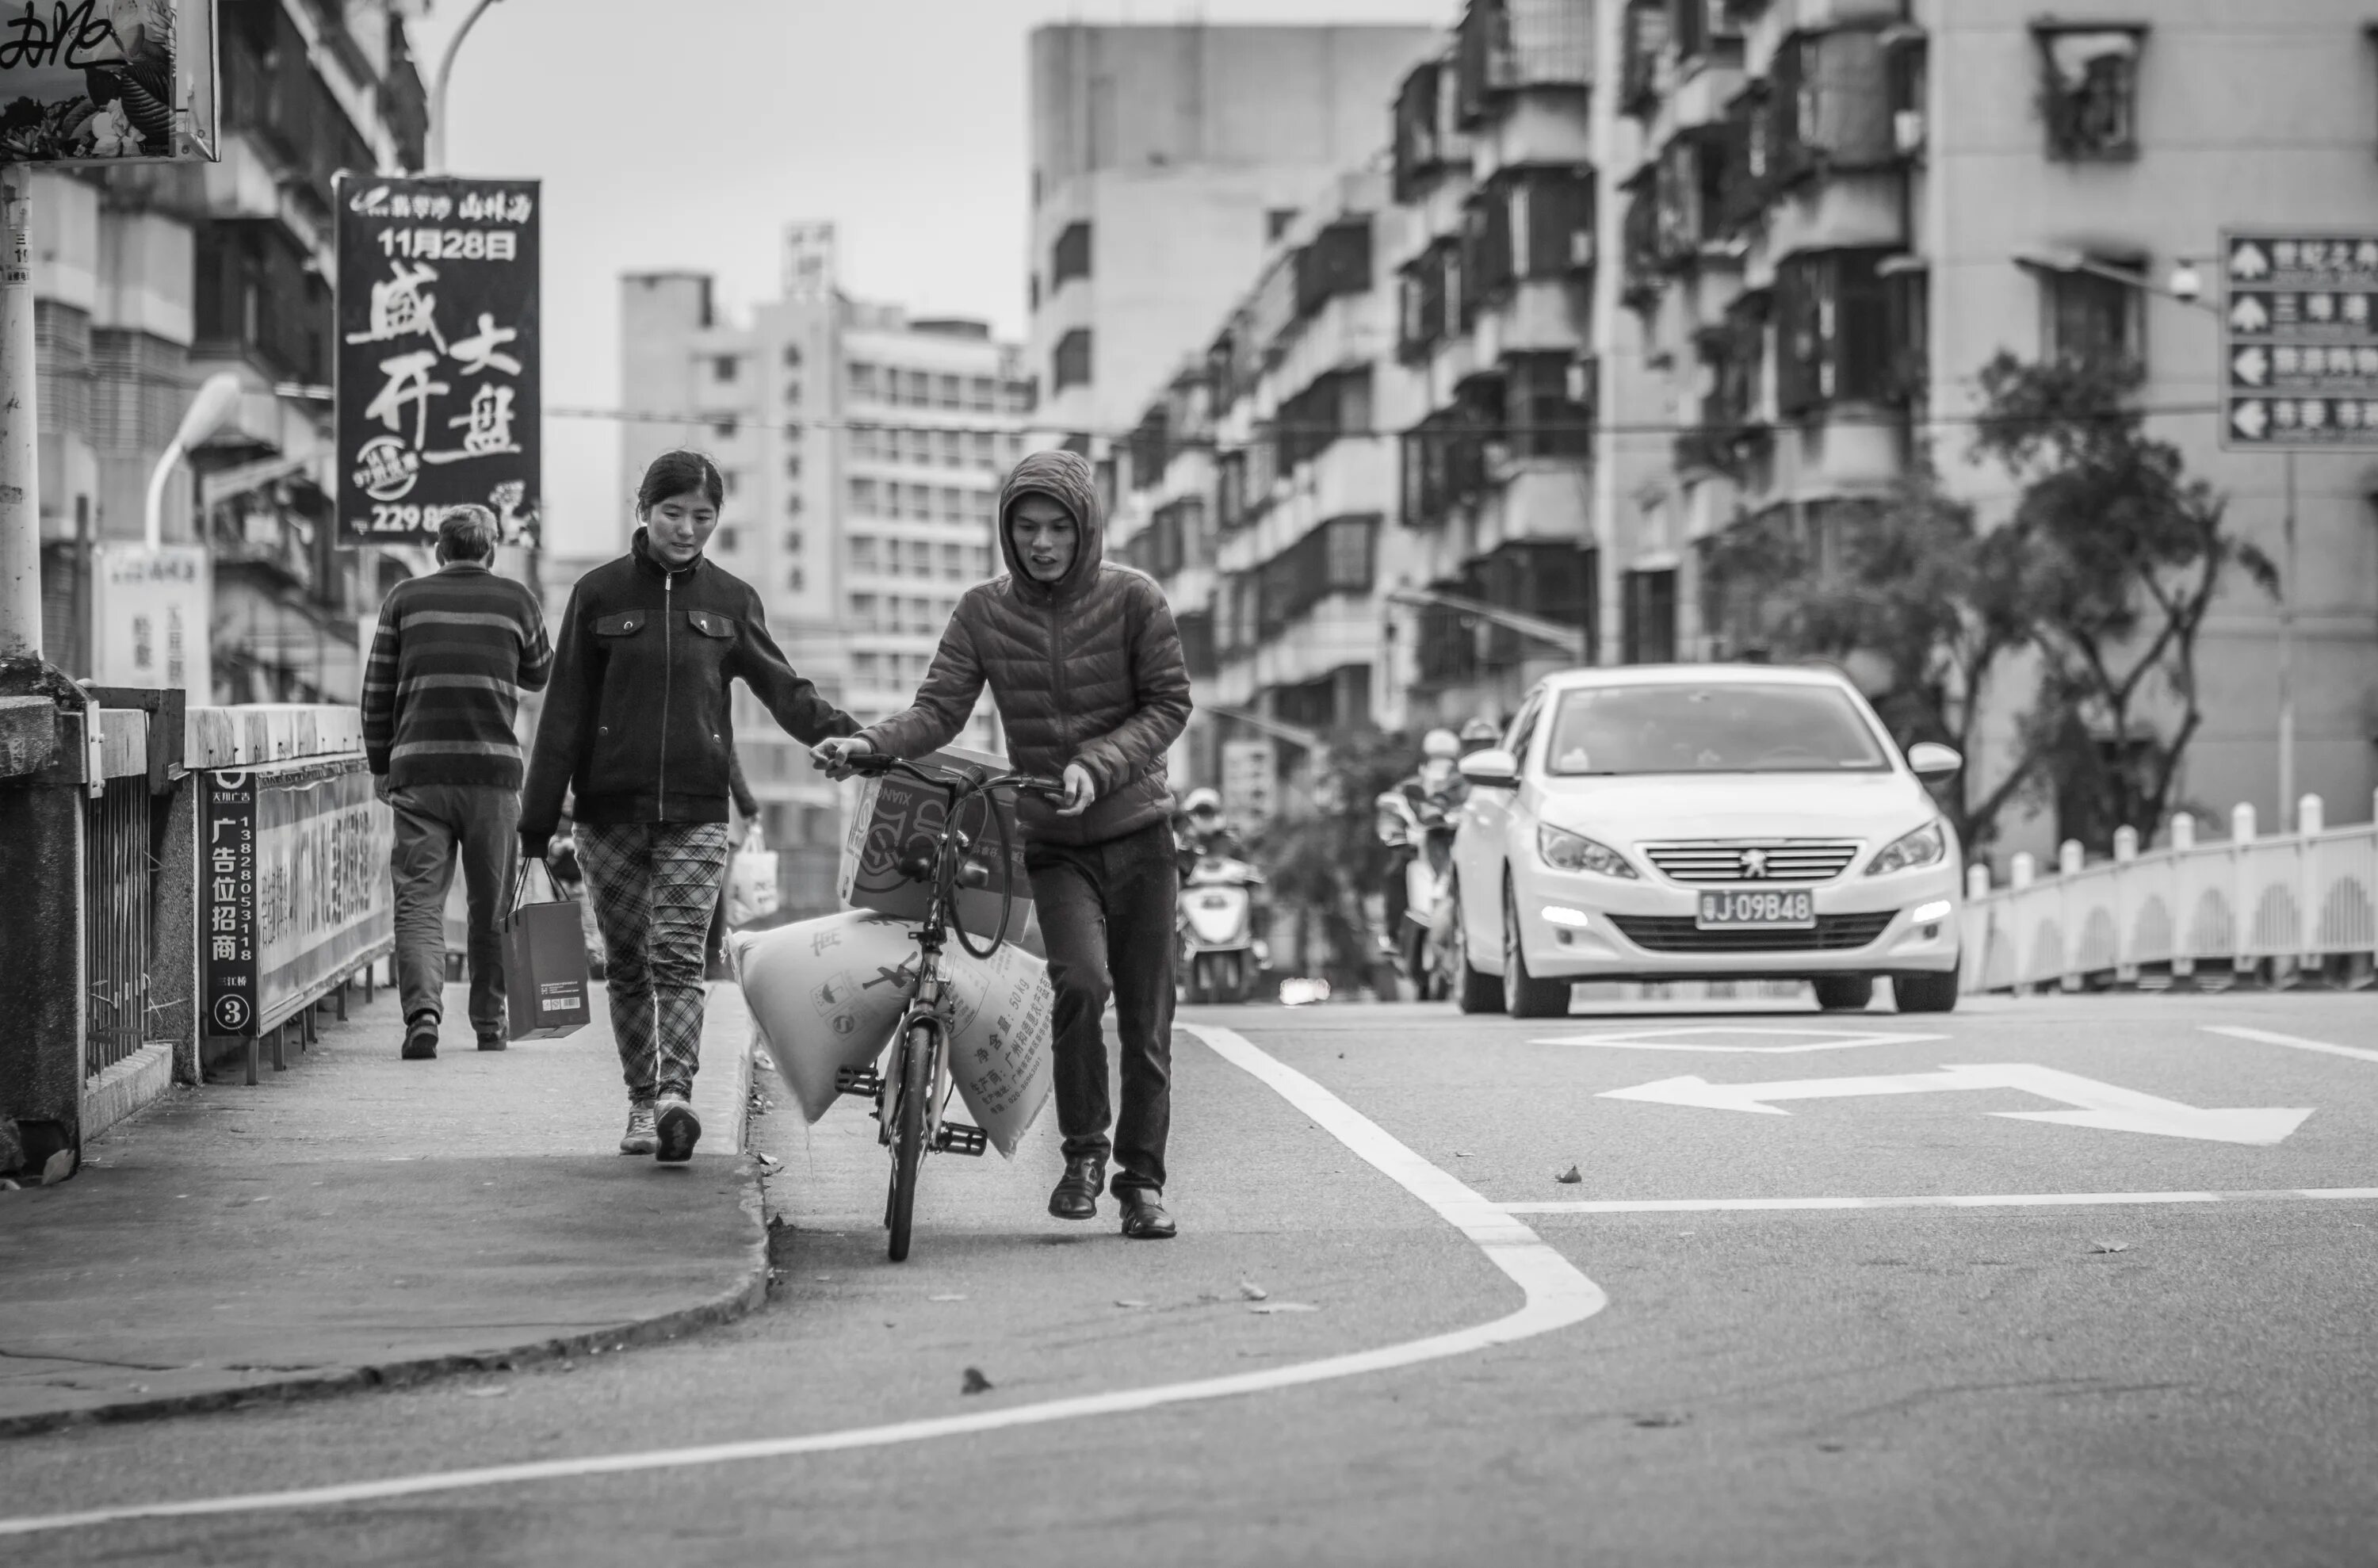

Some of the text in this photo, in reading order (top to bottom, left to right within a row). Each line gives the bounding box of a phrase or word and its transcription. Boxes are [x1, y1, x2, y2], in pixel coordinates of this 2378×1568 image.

[377, 227, 517, 261] 11月28日
[372, 504, 421, 532] 229
[212, 817, 236, 961] 广告位招商
[240, 817, 252, 961] 13828053118
[224, 1000, 241, 1023] 3
